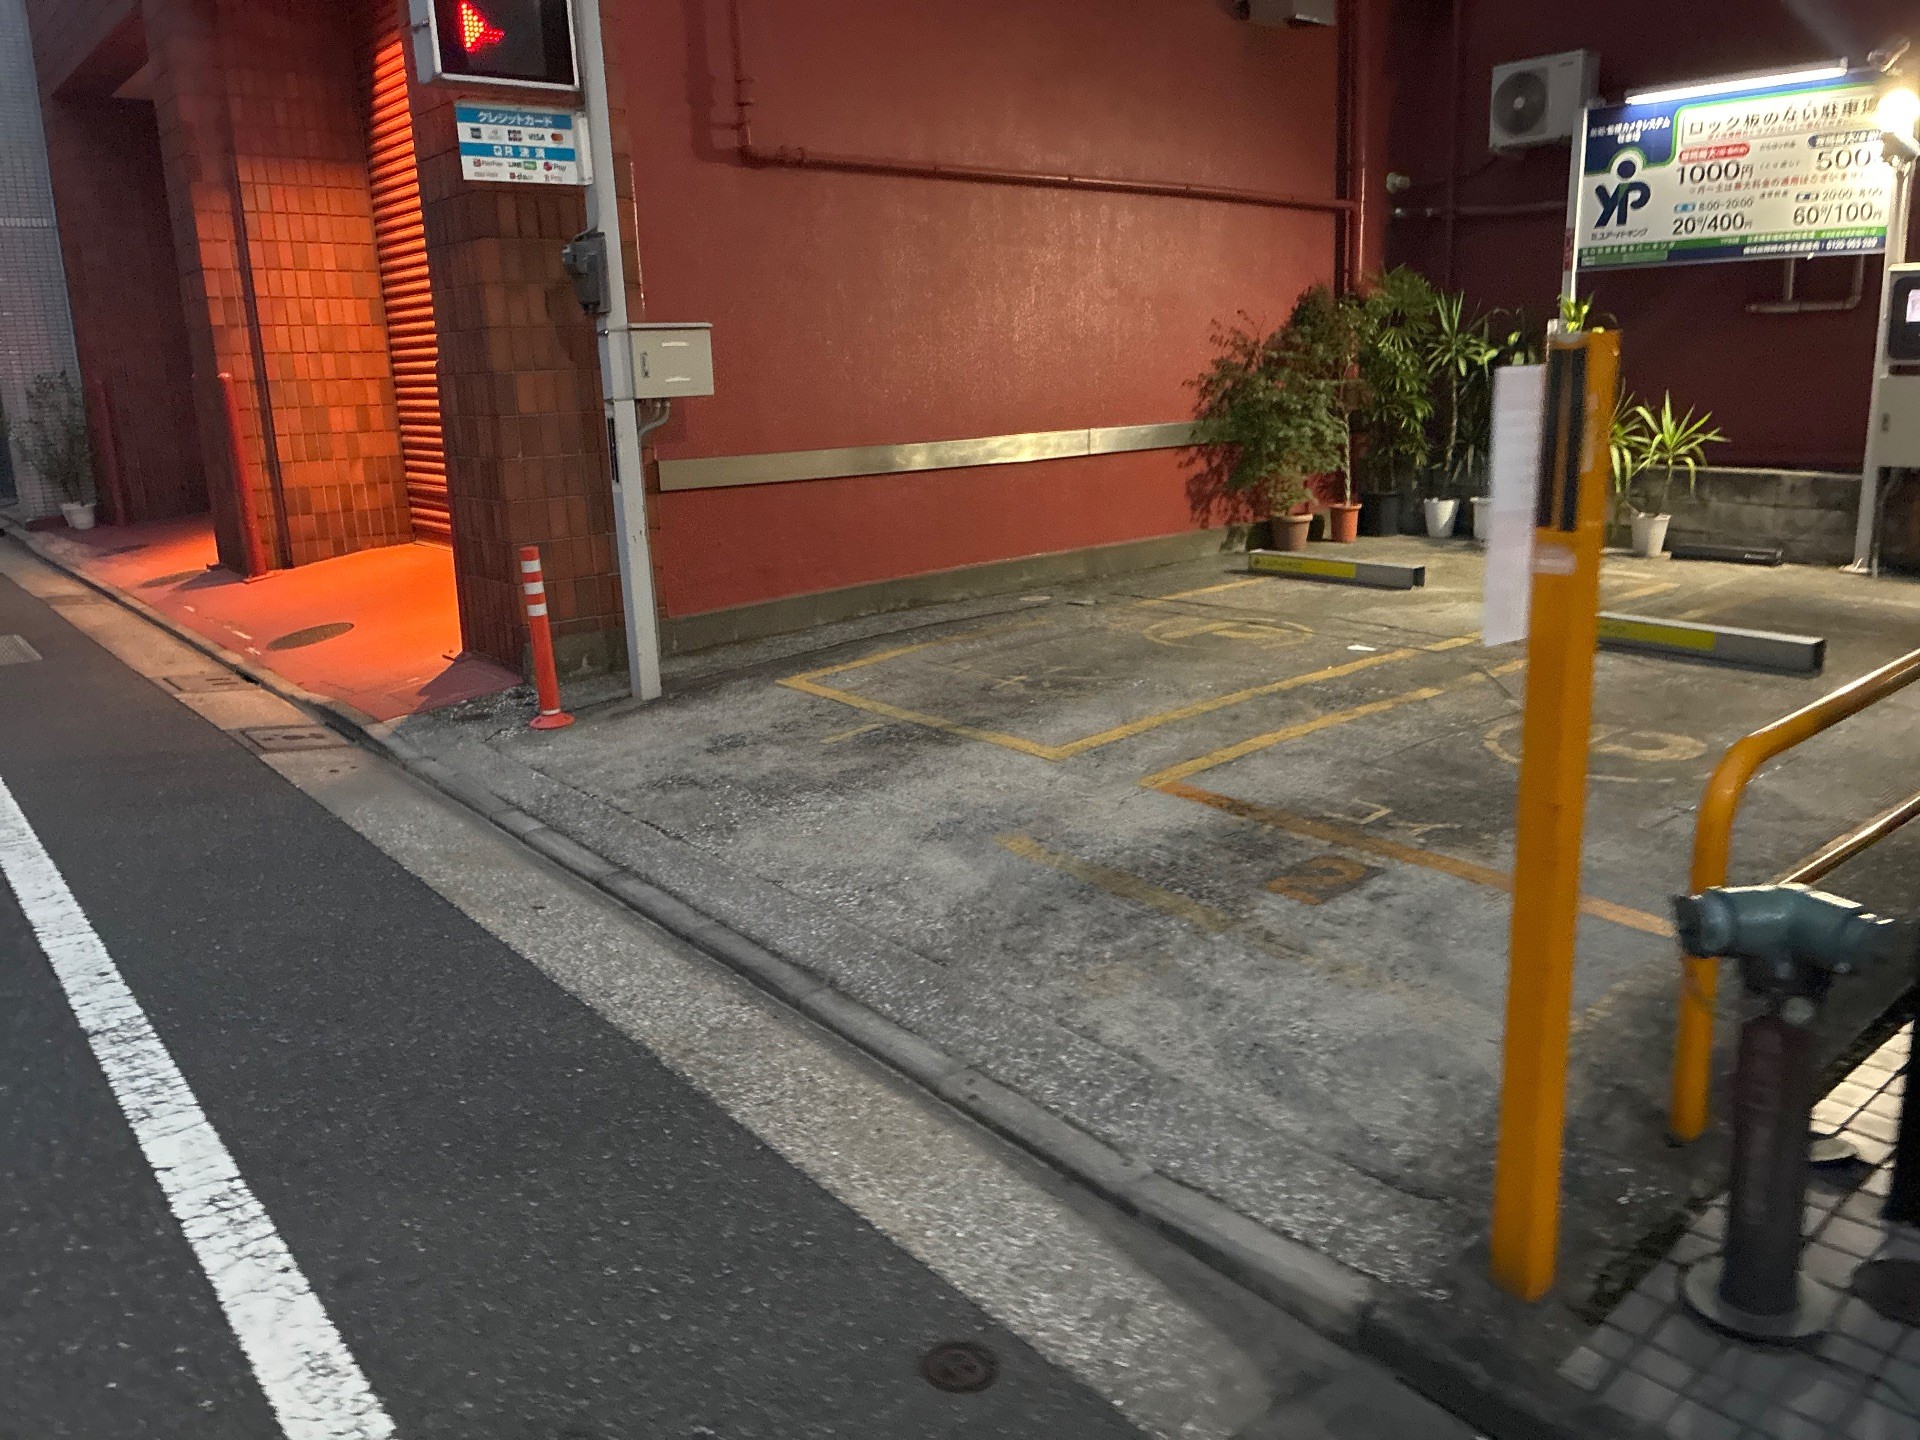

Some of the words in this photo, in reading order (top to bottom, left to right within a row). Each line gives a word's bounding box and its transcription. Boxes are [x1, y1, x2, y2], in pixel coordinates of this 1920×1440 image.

[478, 111, 553, 126] クレジットカード
[528, 133, 545, 141] VISA
[1676, 160, 1754, 185] 1000円
